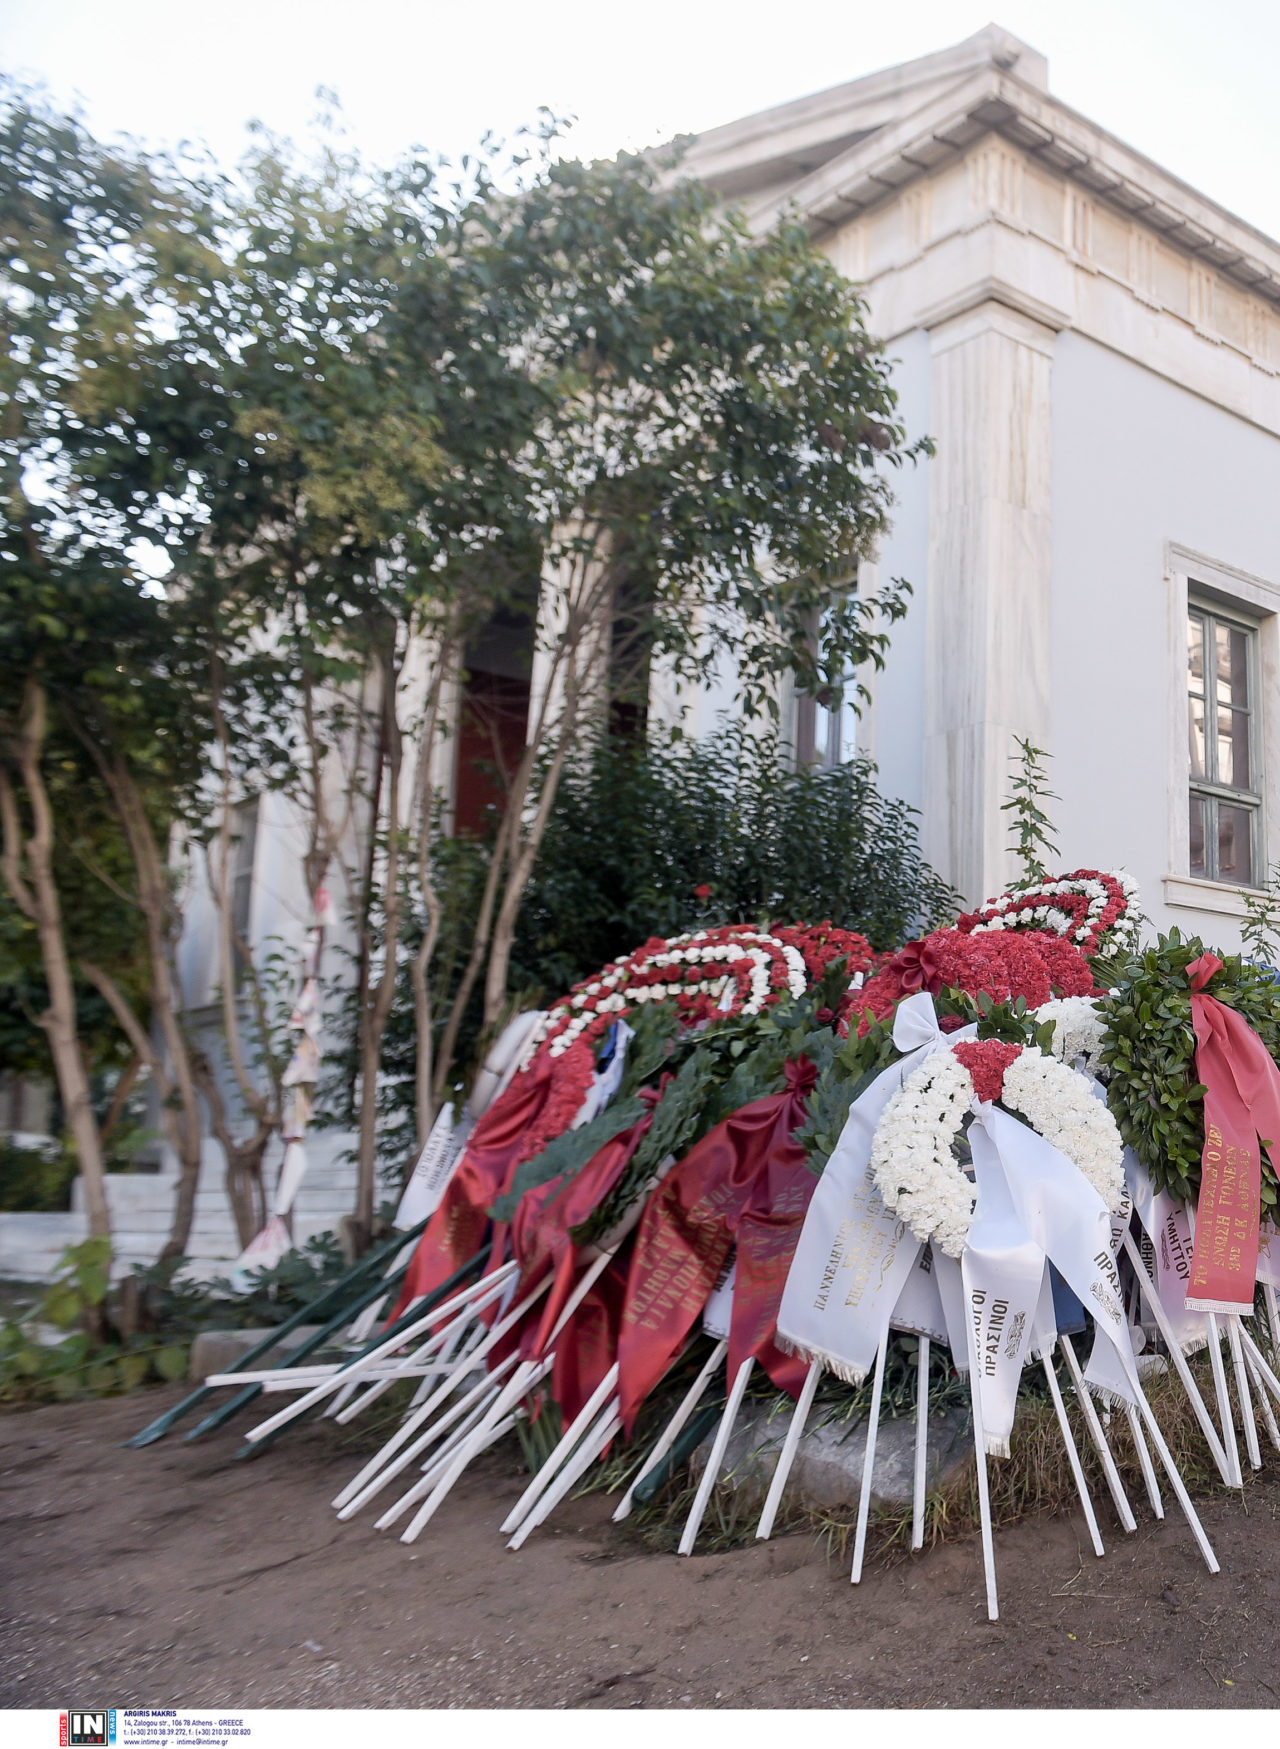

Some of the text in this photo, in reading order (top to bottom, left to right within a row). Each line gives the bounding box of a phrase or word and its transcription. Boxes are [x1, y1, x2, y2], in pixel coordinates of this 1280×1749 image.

[850, 1164, 878, 1211] ΣΥΛΛΟΓ
[1213, 1144, 1238, 1266] ΕΝΩΣΗ ΓΟΝΕΩΝ
[1238, 1148, 1251, 1211] ΑΘΗΝΑΣ
[1094, 1251, 1121, 1297] ΠΡΑΣ
[1166, 1212, 1190, 1280] ΥΜΗΤΤΟΥ
[1194, 1265, 1208, 1285] ΤΟ
[985, 1299, 1009, 1376] ΠΡΑΣΙΝΟΙ
